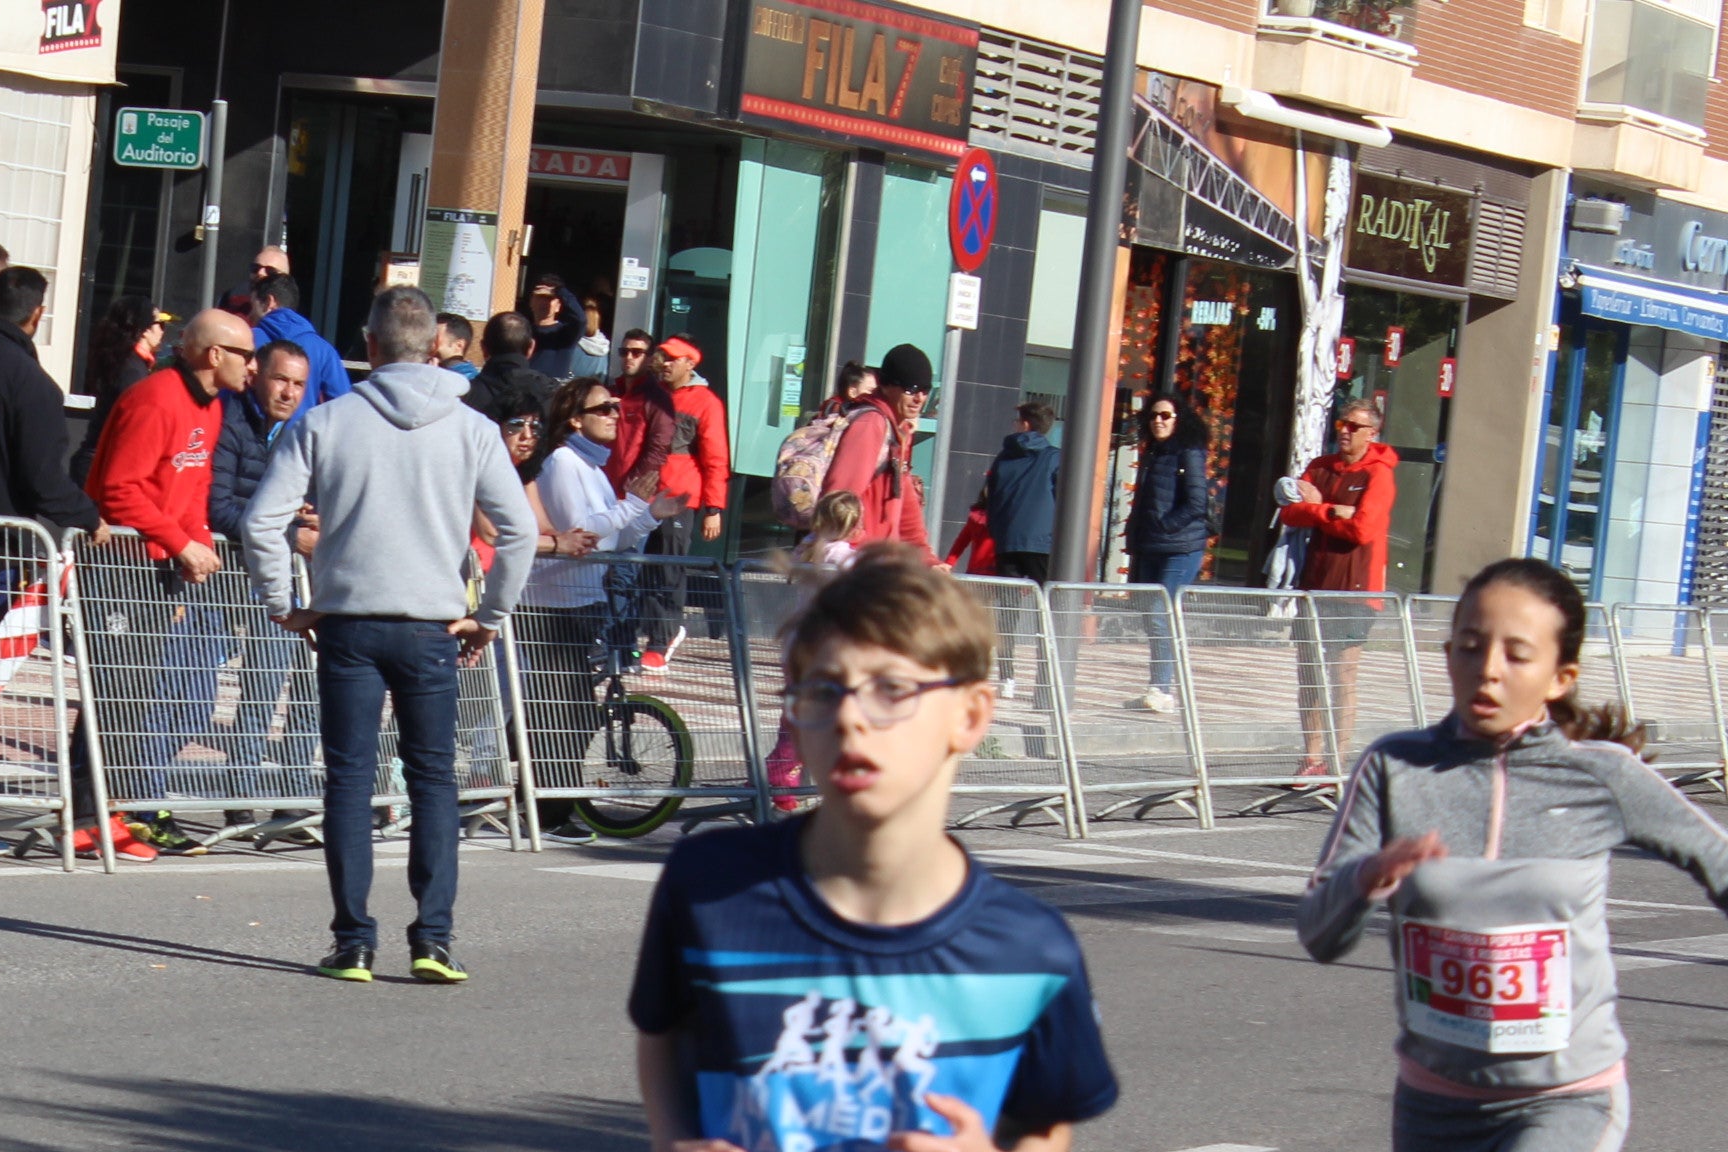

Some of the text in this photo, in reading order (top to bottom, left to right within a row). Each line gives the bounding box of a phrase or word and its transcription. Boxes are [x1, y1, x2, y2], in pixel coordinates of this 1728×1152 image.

[147, 113, 191, 131] Pasaje
[157, 132, 174, 144] del
[121, 143, 196, 164] Auditorio
[1357, 194, 1452, 273] RADIKAL
[1190, 300, 1235, 327] REBAJAS
[1440, 959, 1523, 1001] 963
